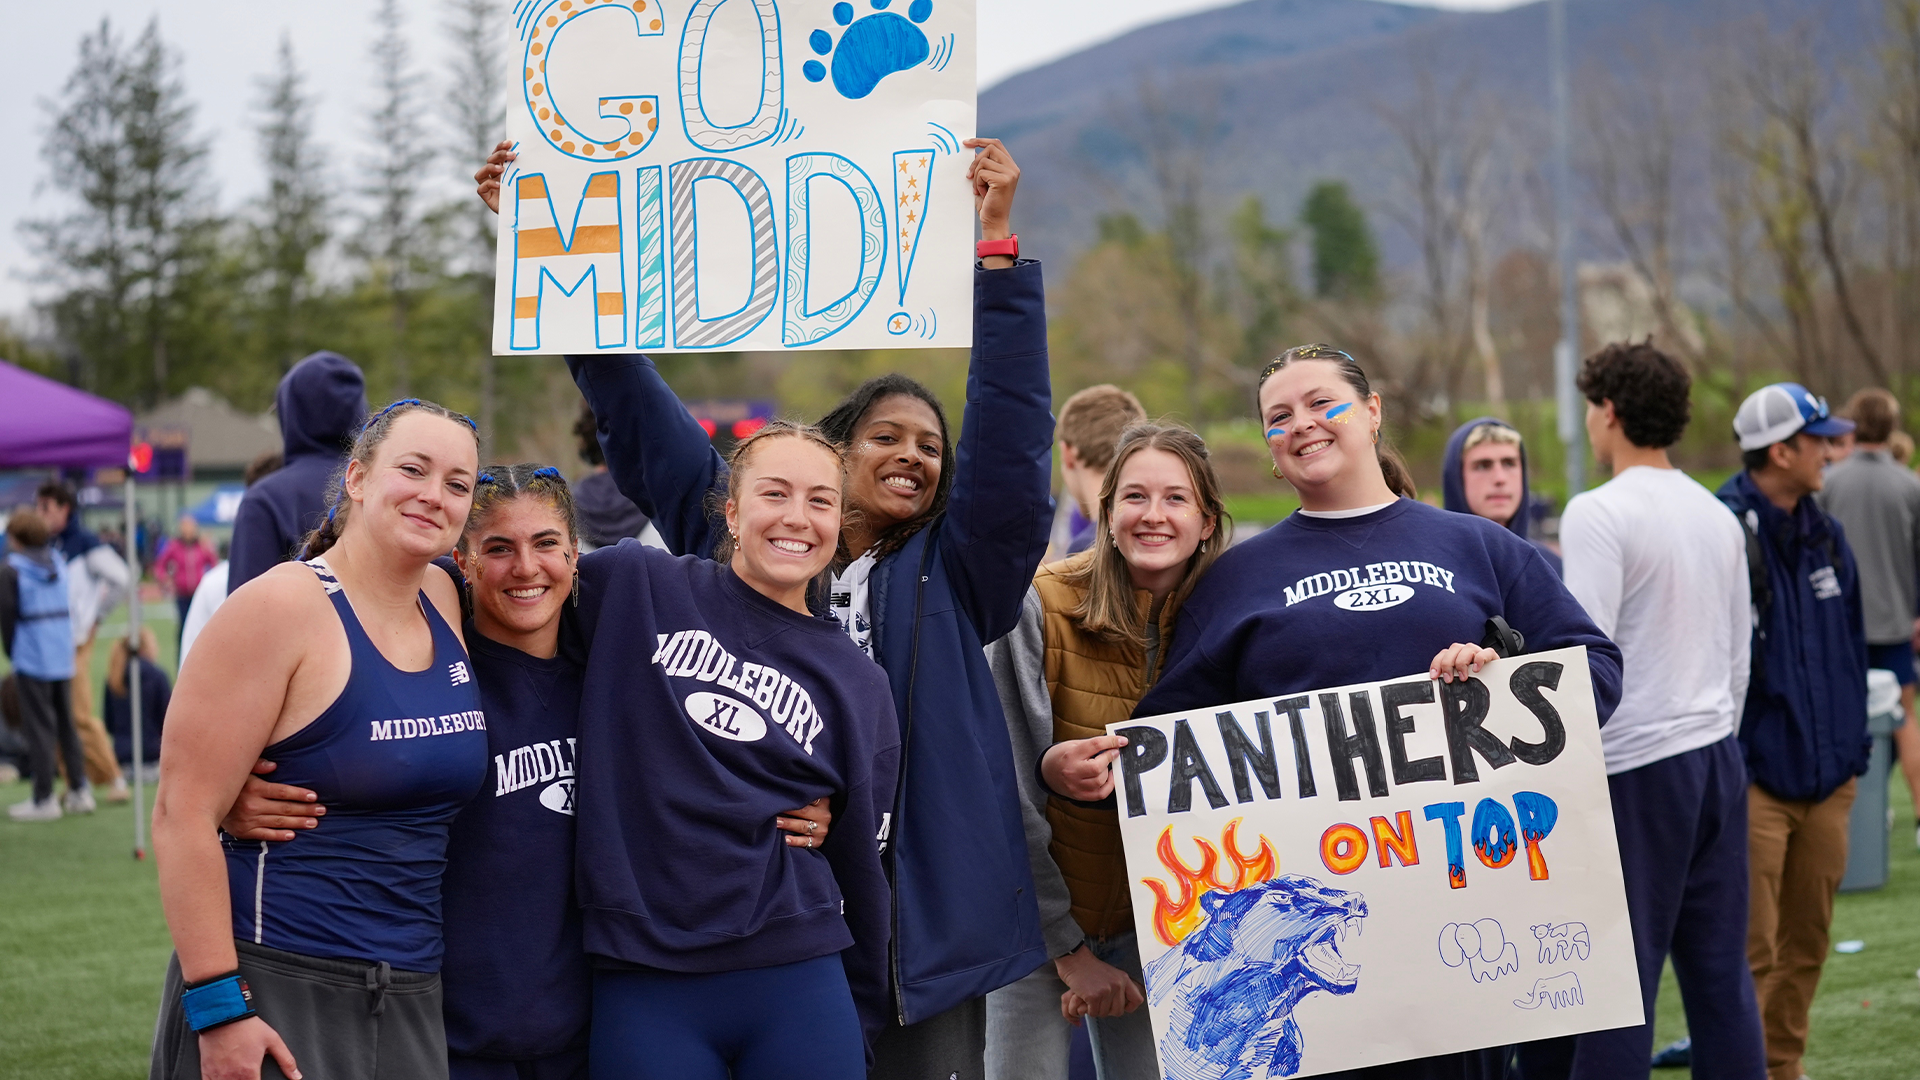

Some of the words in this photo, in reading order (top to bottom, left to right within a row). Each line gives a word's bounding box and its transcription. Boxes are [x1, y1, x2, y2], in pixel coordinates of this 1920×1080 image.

[523, 0, 784, 163] GO
[509, 149, 936, 350] MIDD!
[1282, 560, 1456, 607] MIDDLEBURY
[1348, 587, 1400, 608] 2XL
[651, 629, 824, 756] MIDDLEBURY
[703, 698, 741, 736] XL
[1114, 660, 1566, 818] PANTHERS
[1319, 810, 1420, 875] ON
[1423, 791, 1559, 889] TOP
